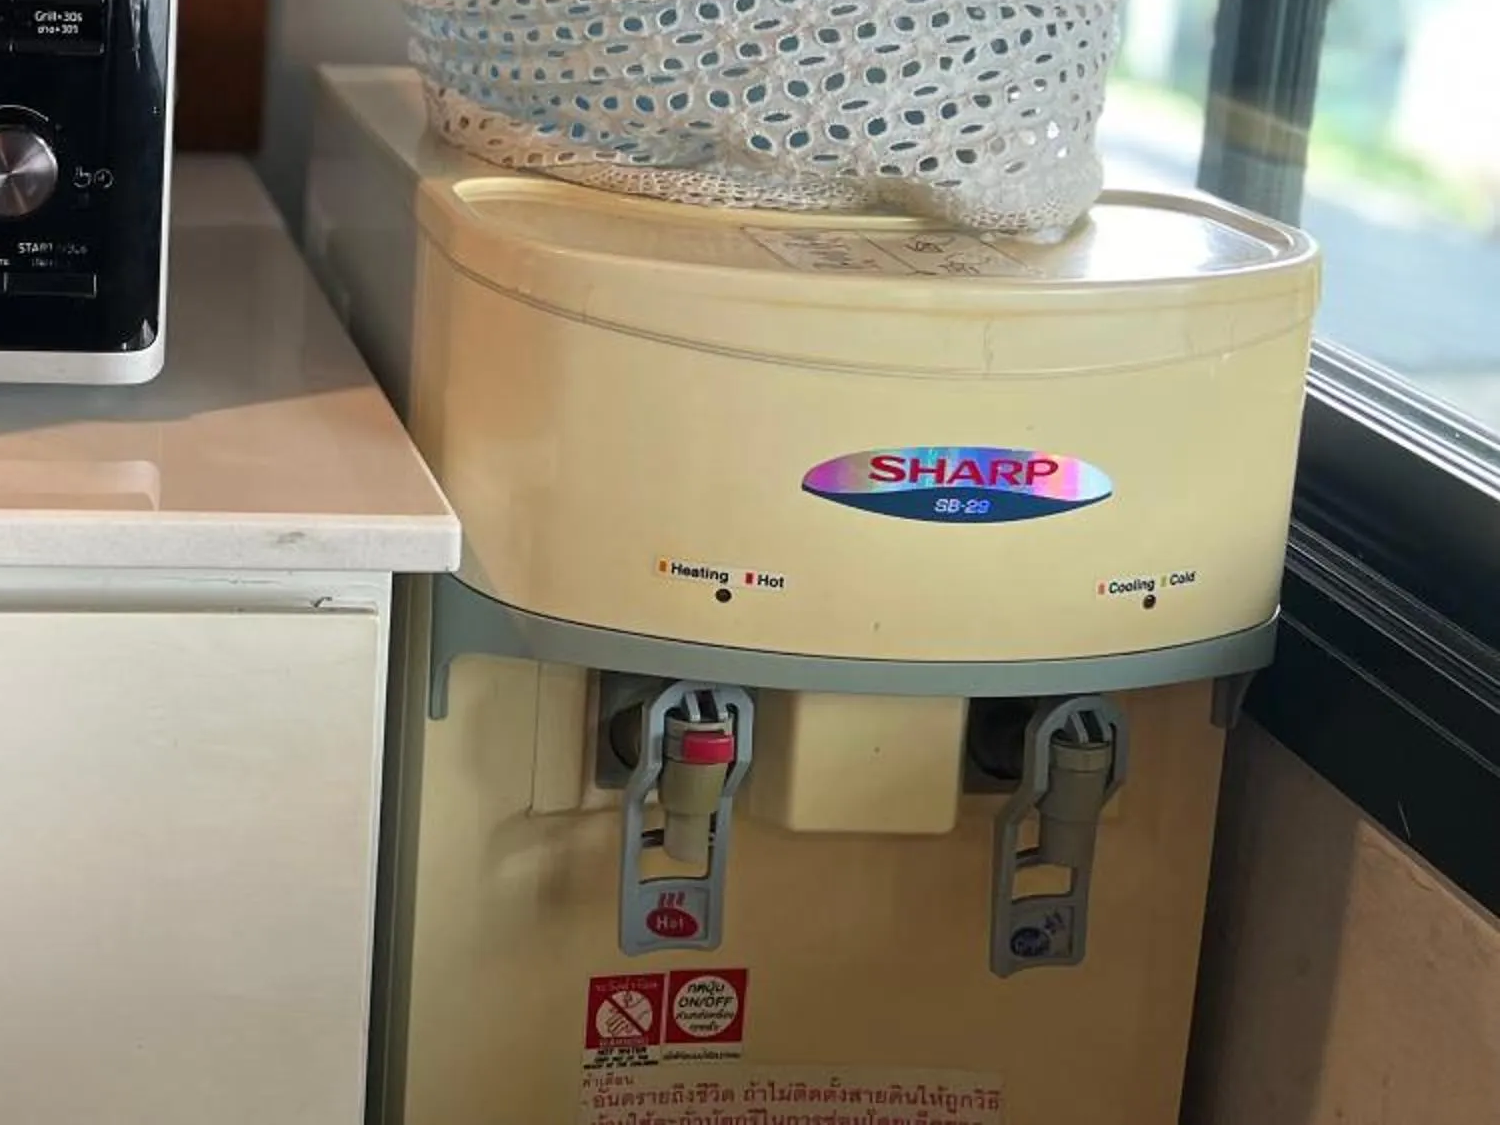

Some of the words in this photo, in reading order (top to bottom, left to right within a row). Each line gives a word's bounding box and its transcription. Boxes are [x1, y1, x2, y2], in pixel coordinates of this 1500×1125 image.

[869, 455, 1059, 486] SHARP
[670, 562, 729, 584] Heating
[1169, 571, 1196, 586] Cold
[757, 574, 785, 589] Hot
[1109, 579, 1156, 594] Cooling
[677, 996, 734, 1008] ON/OFF
